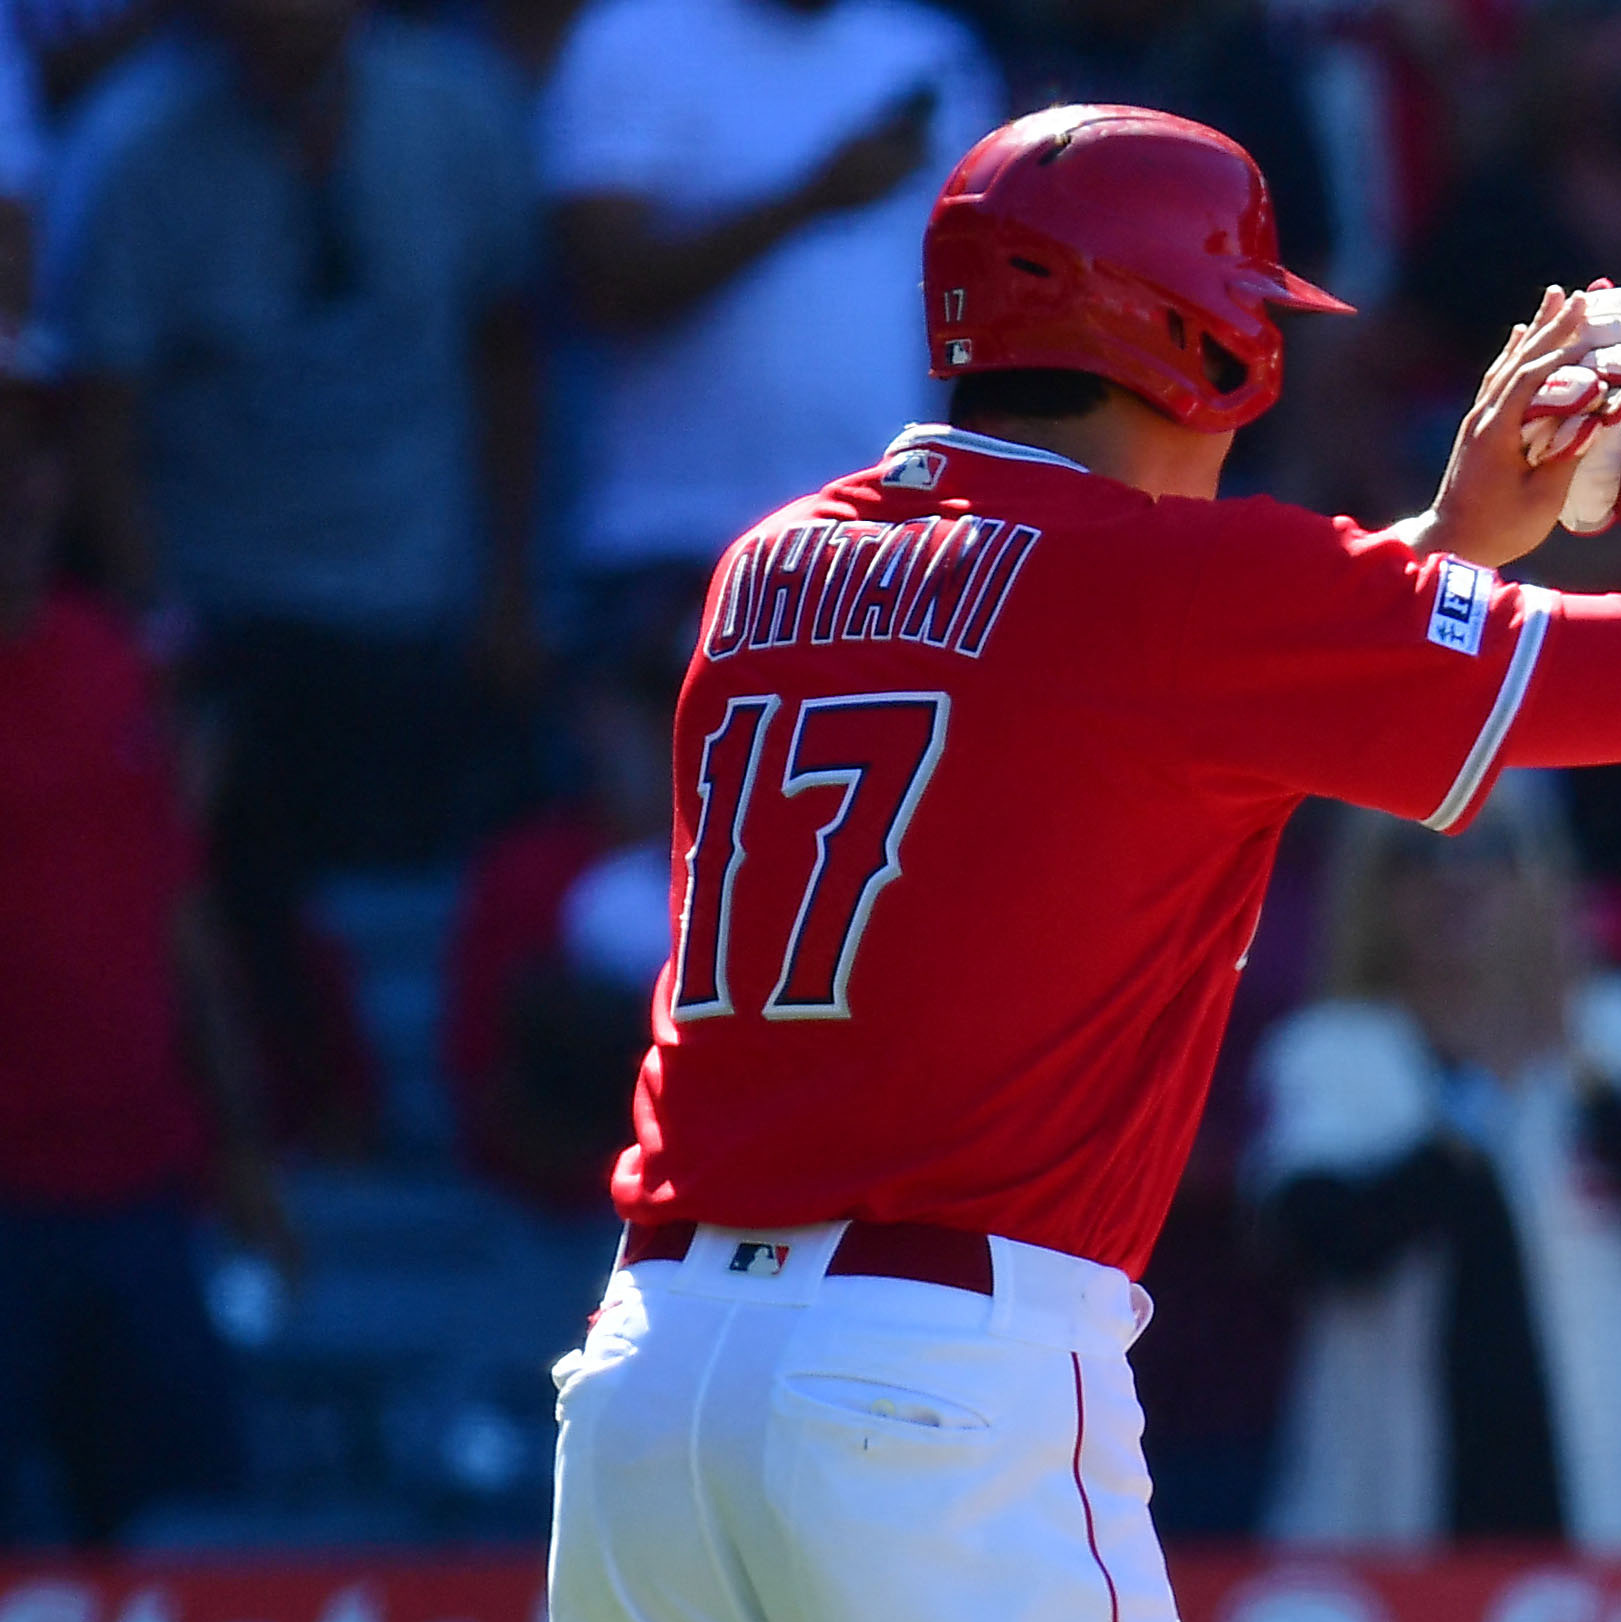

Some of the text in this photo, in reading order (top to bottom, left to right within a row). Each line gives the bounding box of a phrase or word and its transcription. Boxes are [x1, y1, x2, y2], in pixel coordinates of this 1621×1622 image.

[944, 288, 965, 323] 17
[703, 514, 1041, 661] OHTANI
[670, 691, 951, 1023] 17
